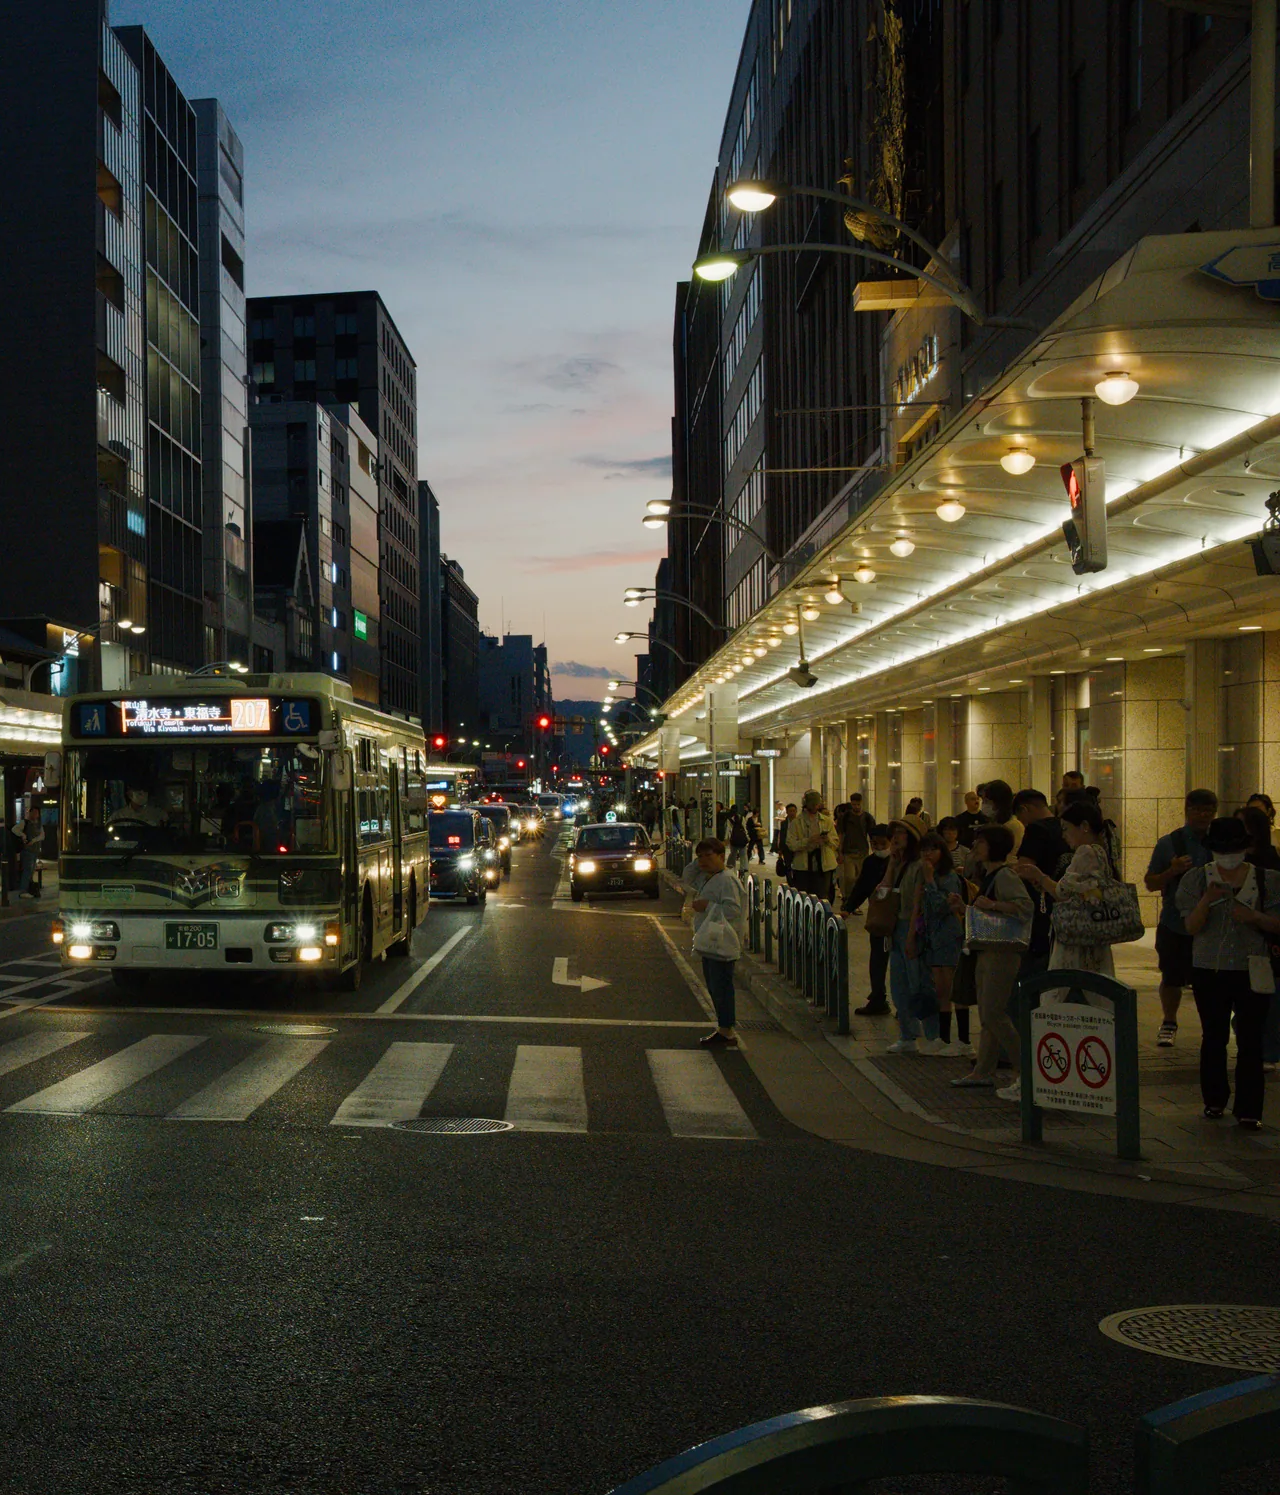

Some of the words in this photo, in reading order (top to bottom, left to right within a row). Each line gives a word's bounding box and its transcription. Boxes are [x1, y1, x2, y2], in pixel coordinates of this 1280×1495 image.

[135, 707, 221, 719] 清水寺・東福寺
[232, 701, 267, 728] 207
[160, 719, 184, 727] Temple
[207, 723, 232, 732] Temple
[1091, 900, 1120, 922] alo
[176, 932, 215, 948] 17-05
